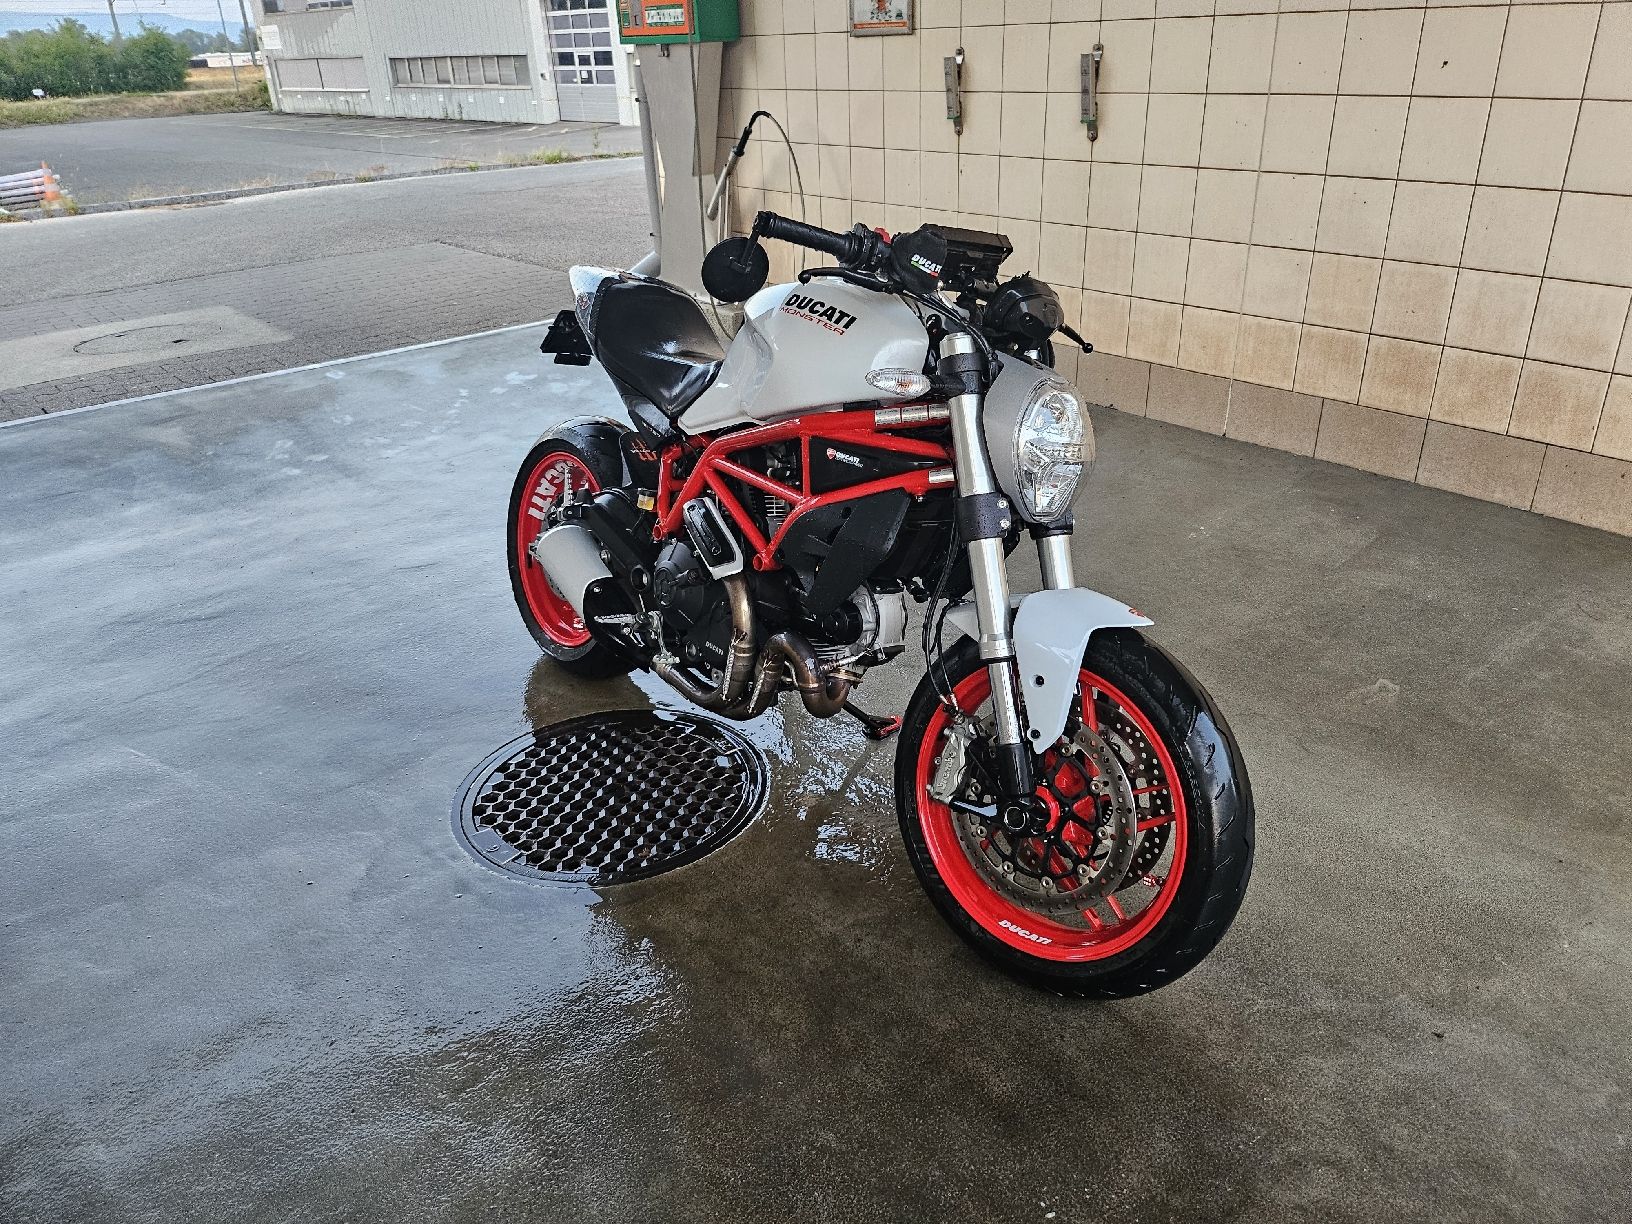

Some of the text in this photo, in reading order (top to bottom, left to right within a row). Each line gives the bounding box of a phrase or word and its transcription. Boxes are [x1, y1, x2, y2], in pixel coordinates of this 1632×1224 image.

[779, 306, 846, 336] MONSTER
[784, 293, 858, 330] DUCATI
[998, 919, 1053, 945] DUCATI
